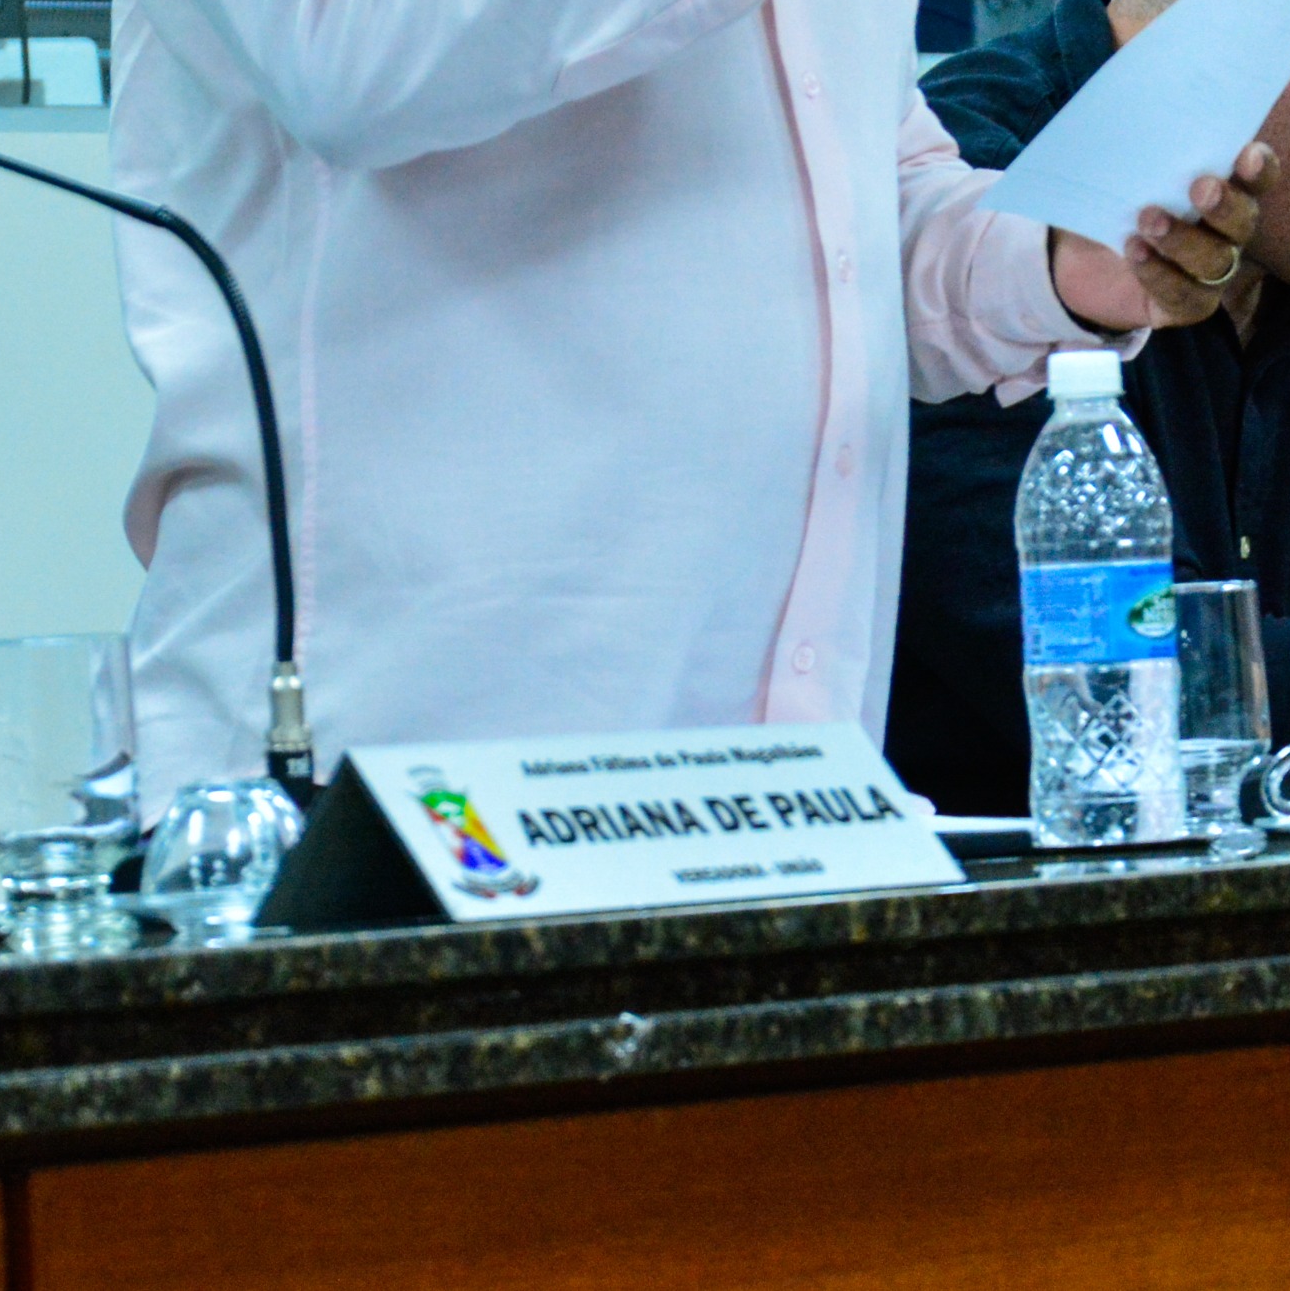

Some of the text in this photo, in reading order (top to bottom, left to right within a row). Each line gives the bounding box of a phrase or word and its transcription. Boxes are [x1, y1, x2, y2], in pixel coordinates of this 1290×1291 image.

[521, 759, 588, 776] Adriana
[518, 784, 905, 846] ADRIANA DE PAULA
